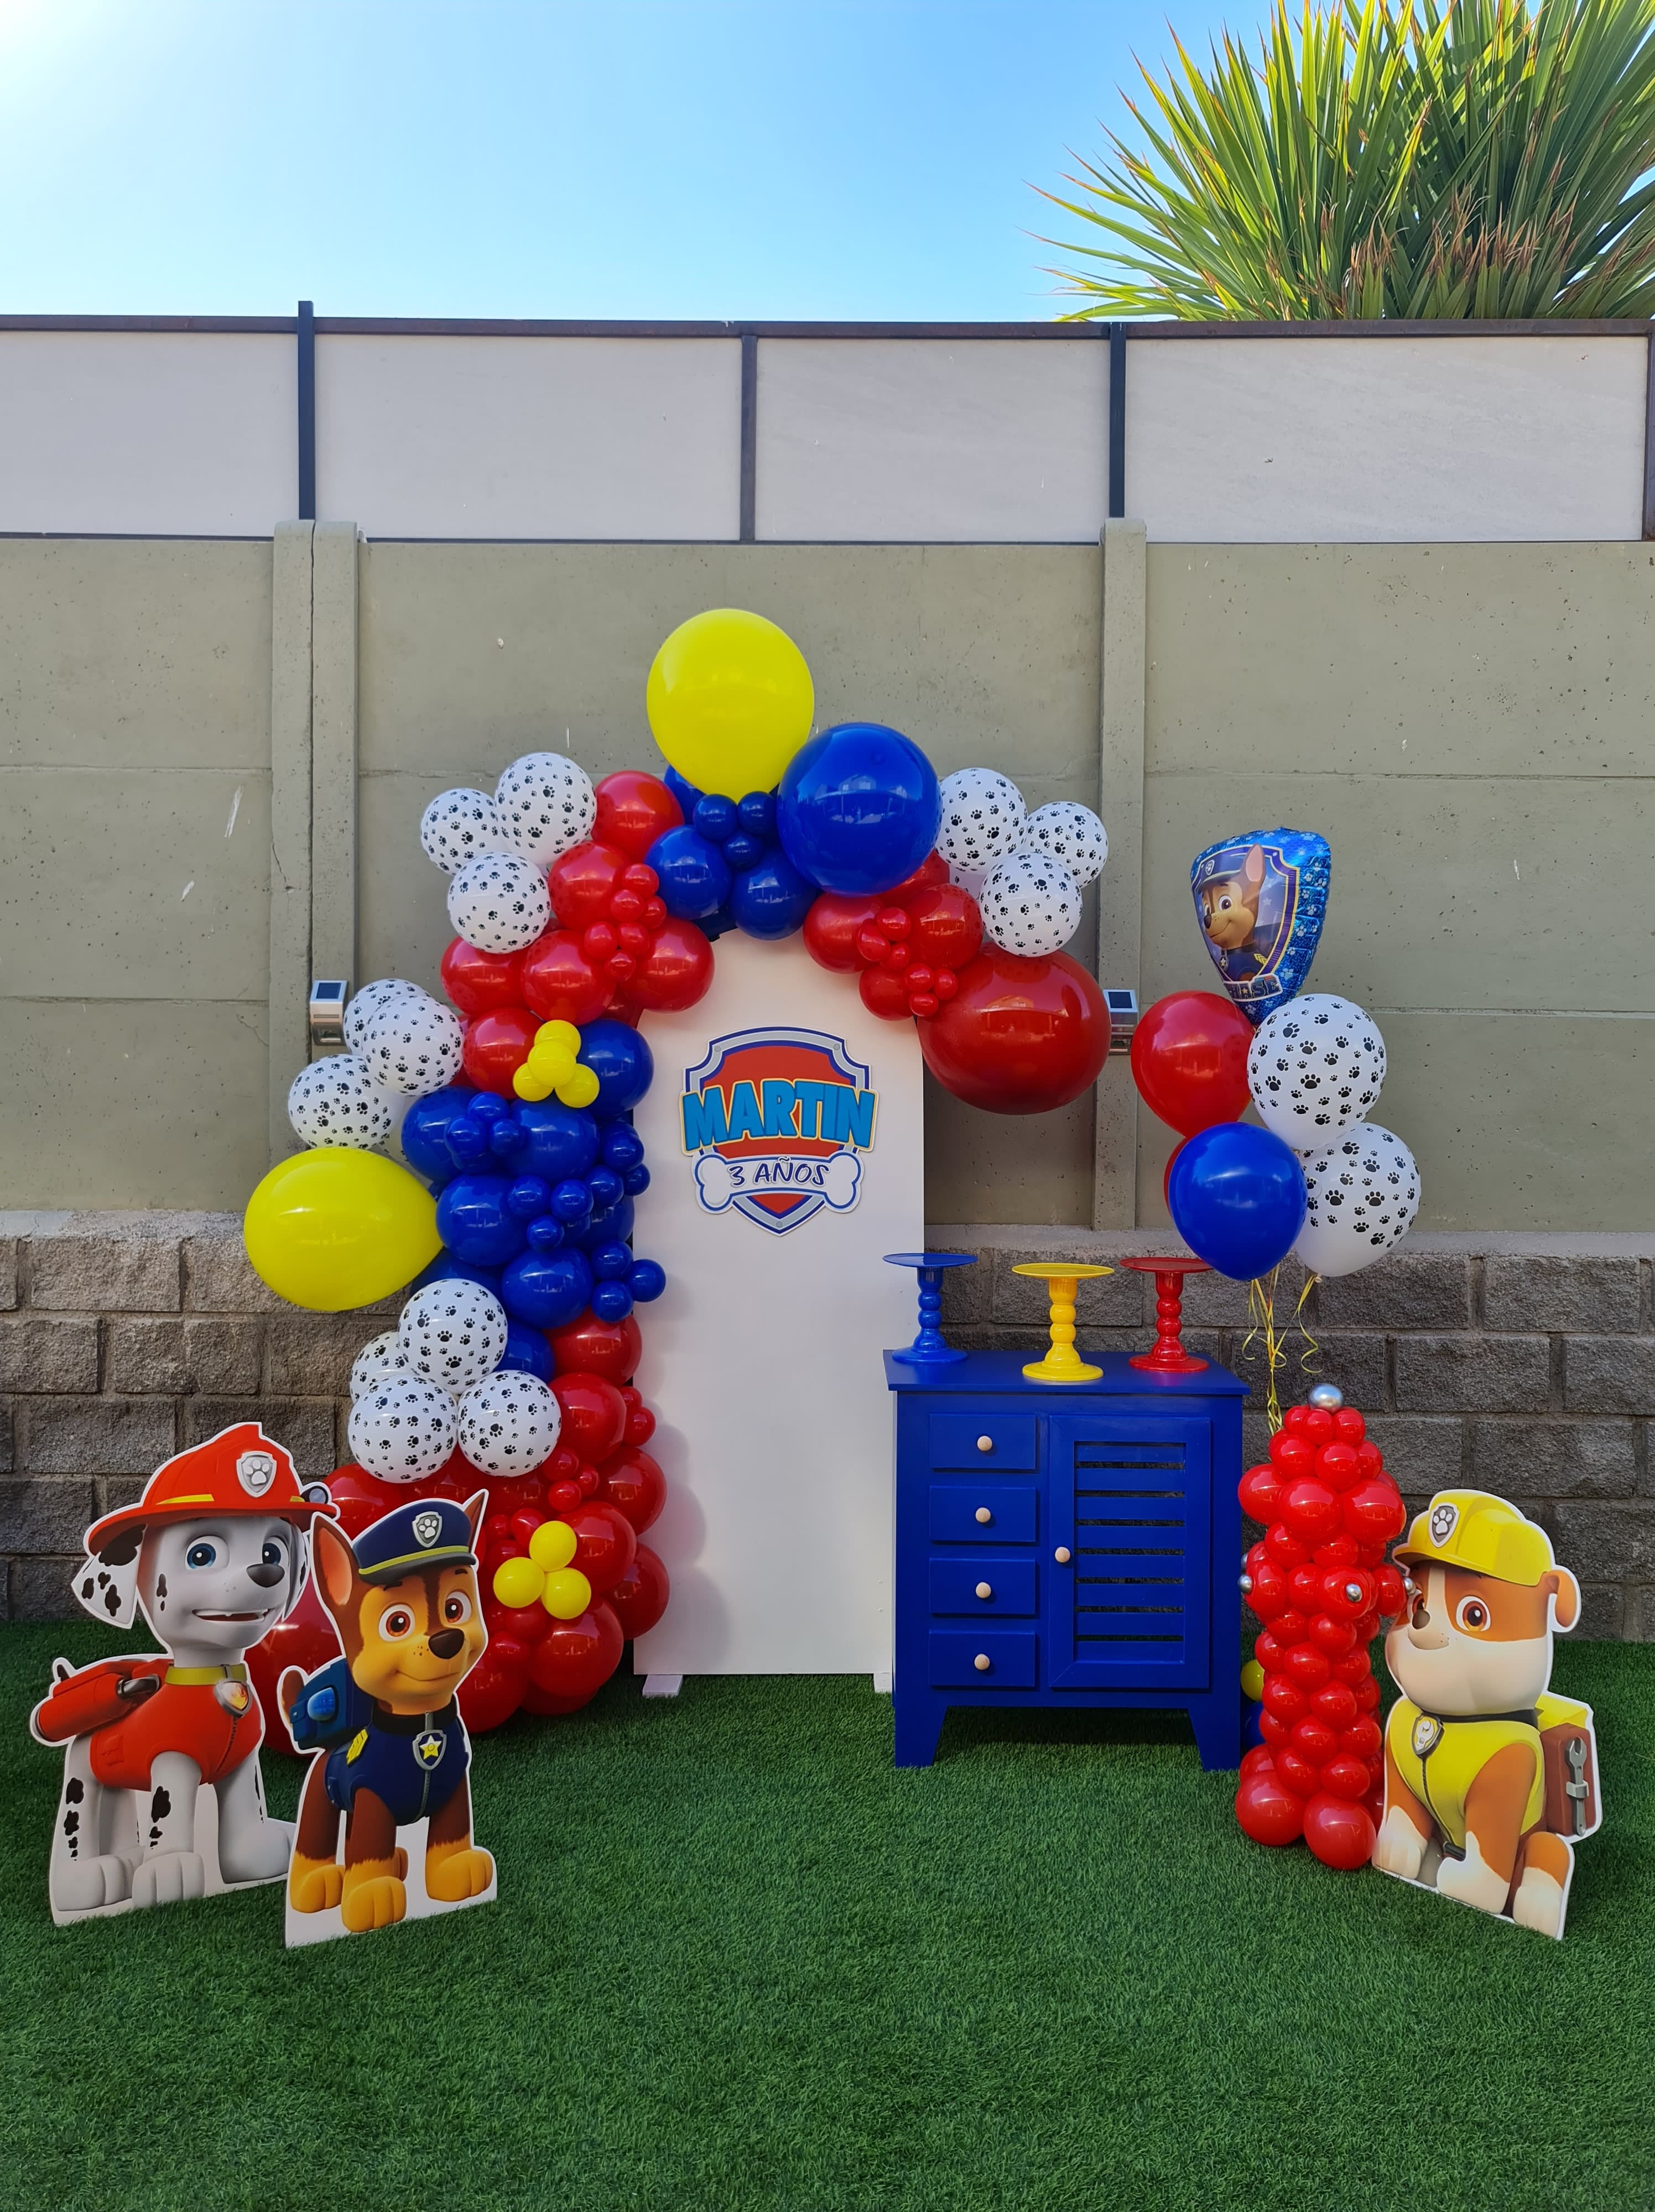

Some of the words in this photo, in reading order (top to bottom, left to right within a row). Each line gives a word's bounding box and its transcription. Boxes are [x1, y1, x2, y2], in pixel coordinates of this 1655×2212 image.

[1224, 978, 1280, 999] HASE
[682, 1079, 876, 1151] MARTIN
[728, 1166, 745, 1185] 3
[754, 1156, 829, 1185] AÑOS
